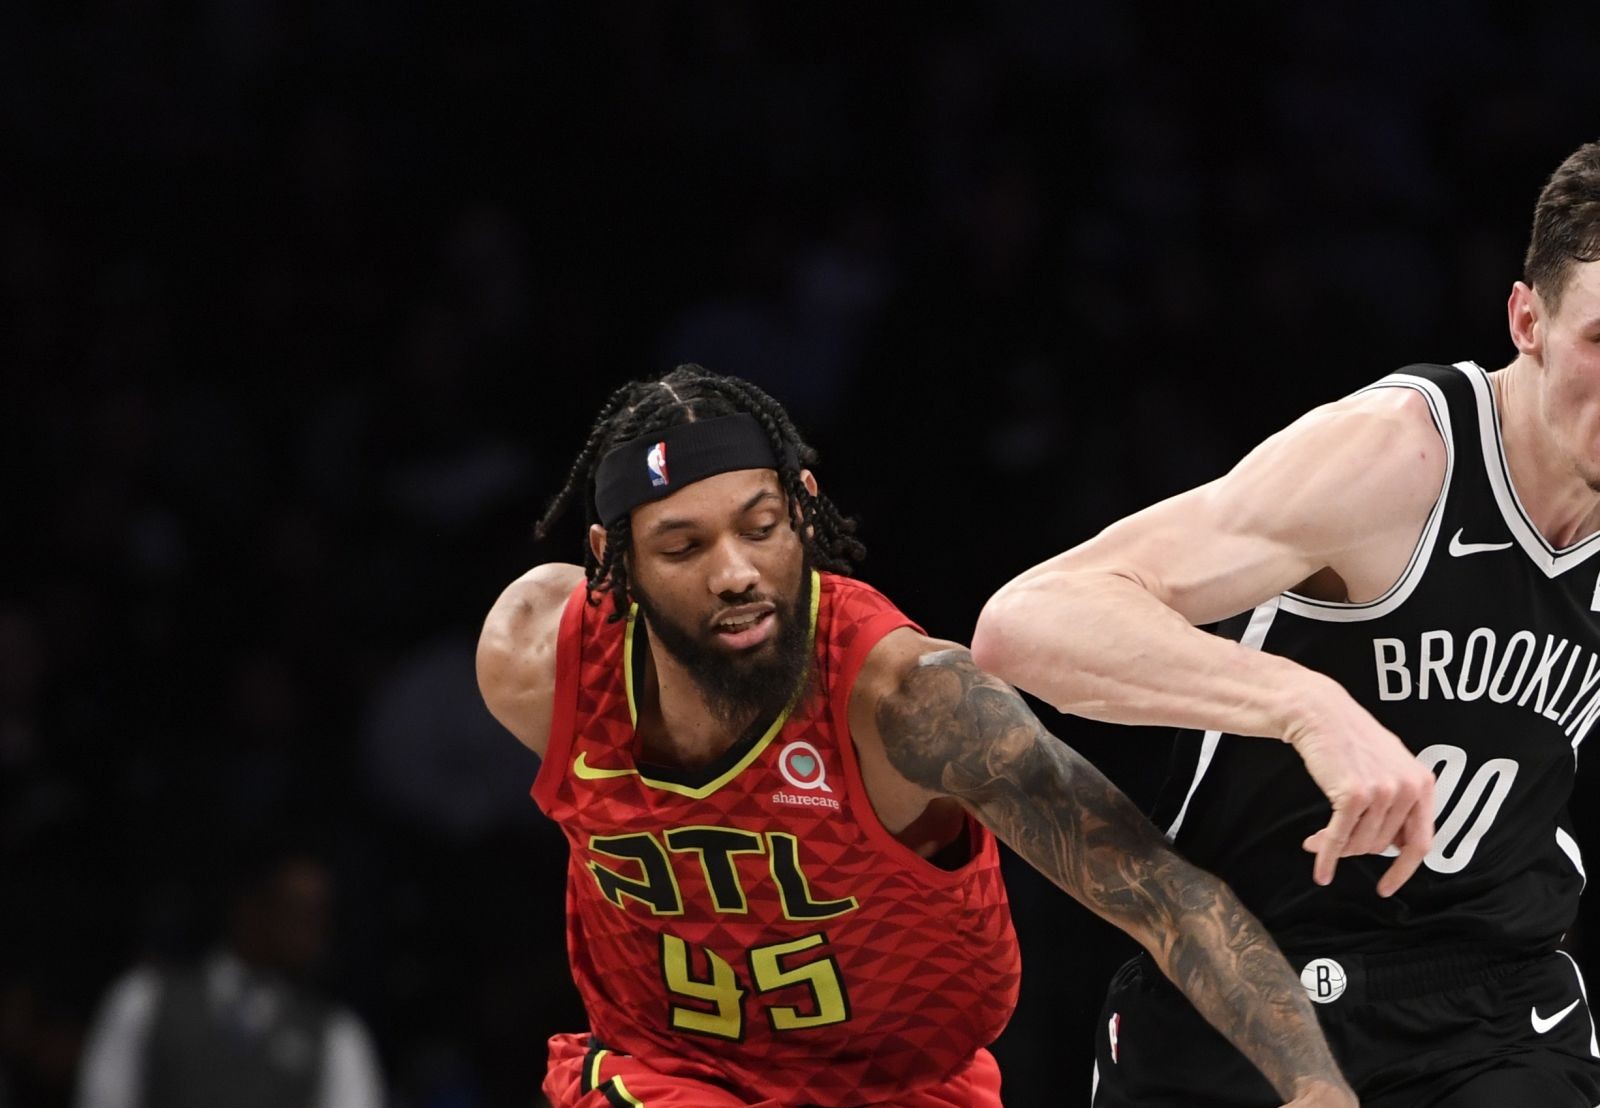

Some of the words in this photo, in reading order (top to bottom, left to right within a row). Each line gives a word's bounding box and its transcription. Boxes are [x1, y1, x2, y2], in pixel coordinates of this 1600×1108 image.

[772, 791, 840, 809] sharecare
[587, 825, 860, 921] ATL
[1316, 965, 1332, 998] B
